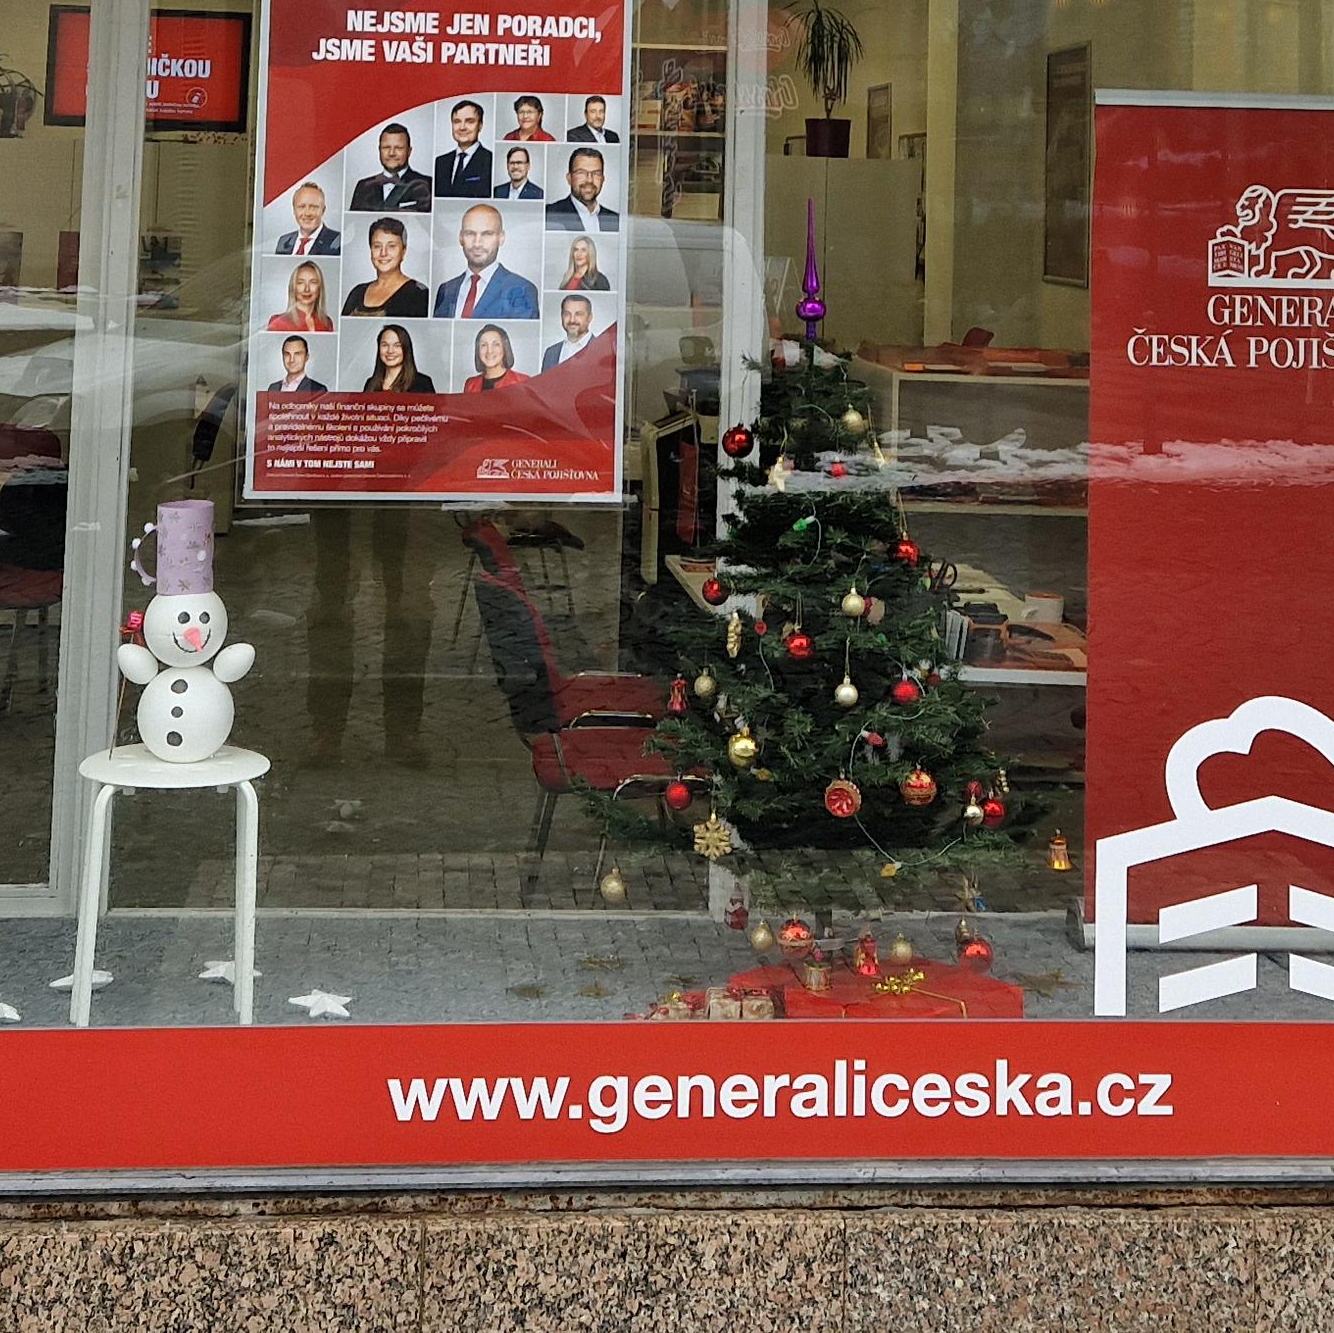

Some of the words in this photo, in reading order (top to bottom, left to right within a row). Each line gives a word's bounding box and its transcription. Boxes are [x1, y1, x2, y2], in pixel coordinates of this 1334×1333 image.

[346, 9, 439, 35] NEJSME
[446, 13, 489, 36] JEN
[497, 14, 602, 43] PORADCI,
[311, 37, 376, 62] JSME
[382, 35, 433, 63] VAŠI
[440, 38, 551, 67] PARTNEŘI
[1127, 327, 1235, 368] ČESKÁ
[387, 1058, 1175, 1135] www.generaliceska.cz
